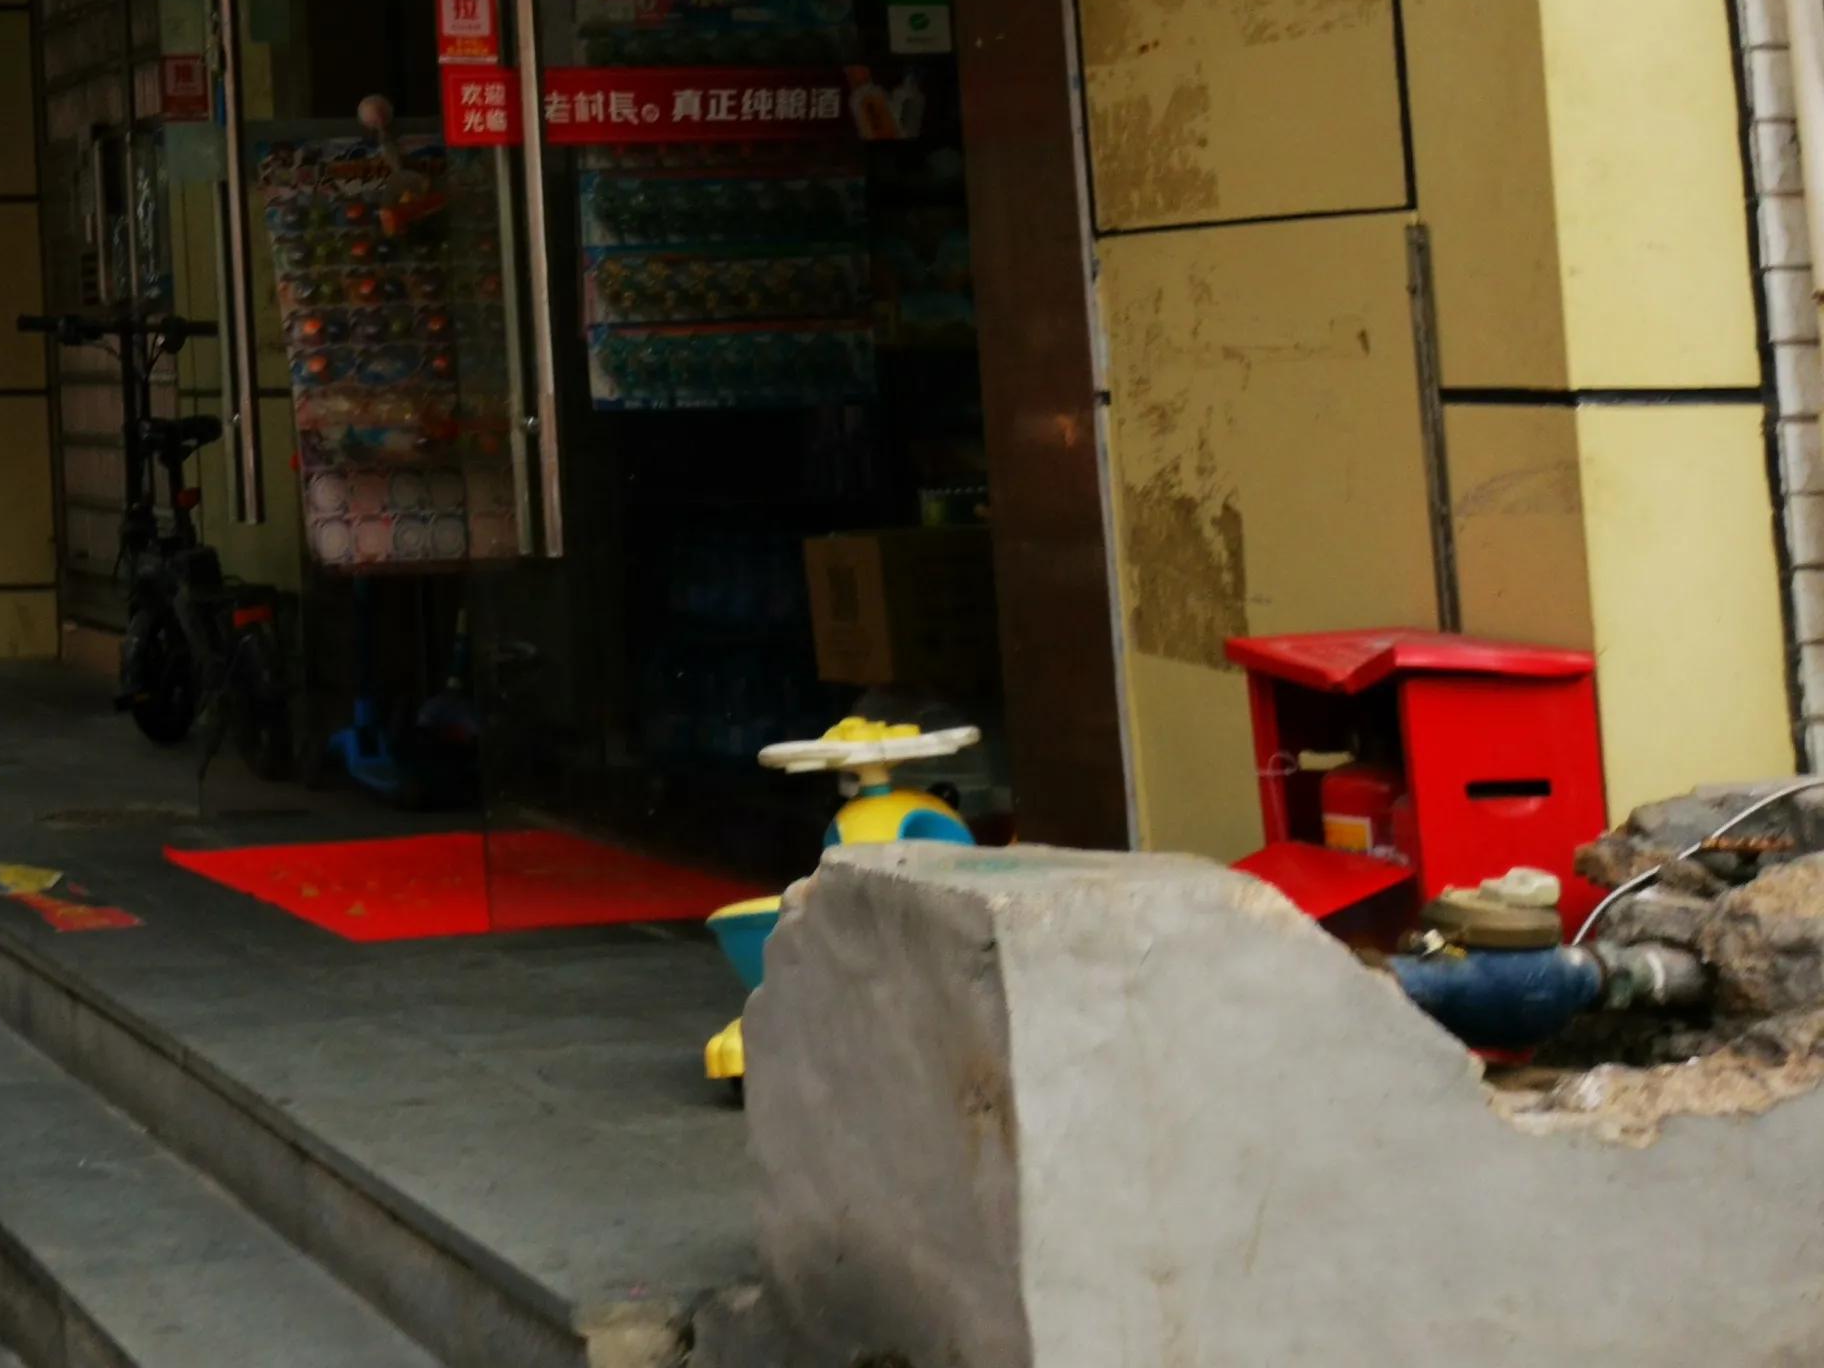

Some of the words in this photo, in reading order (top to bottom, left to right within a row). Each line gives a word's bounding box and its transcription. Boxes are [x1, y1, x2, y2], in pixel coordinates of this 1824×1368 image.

[460, 81, 507, 107] 欢迎
[671, 87, 842, 122] 真正纯粮酒
